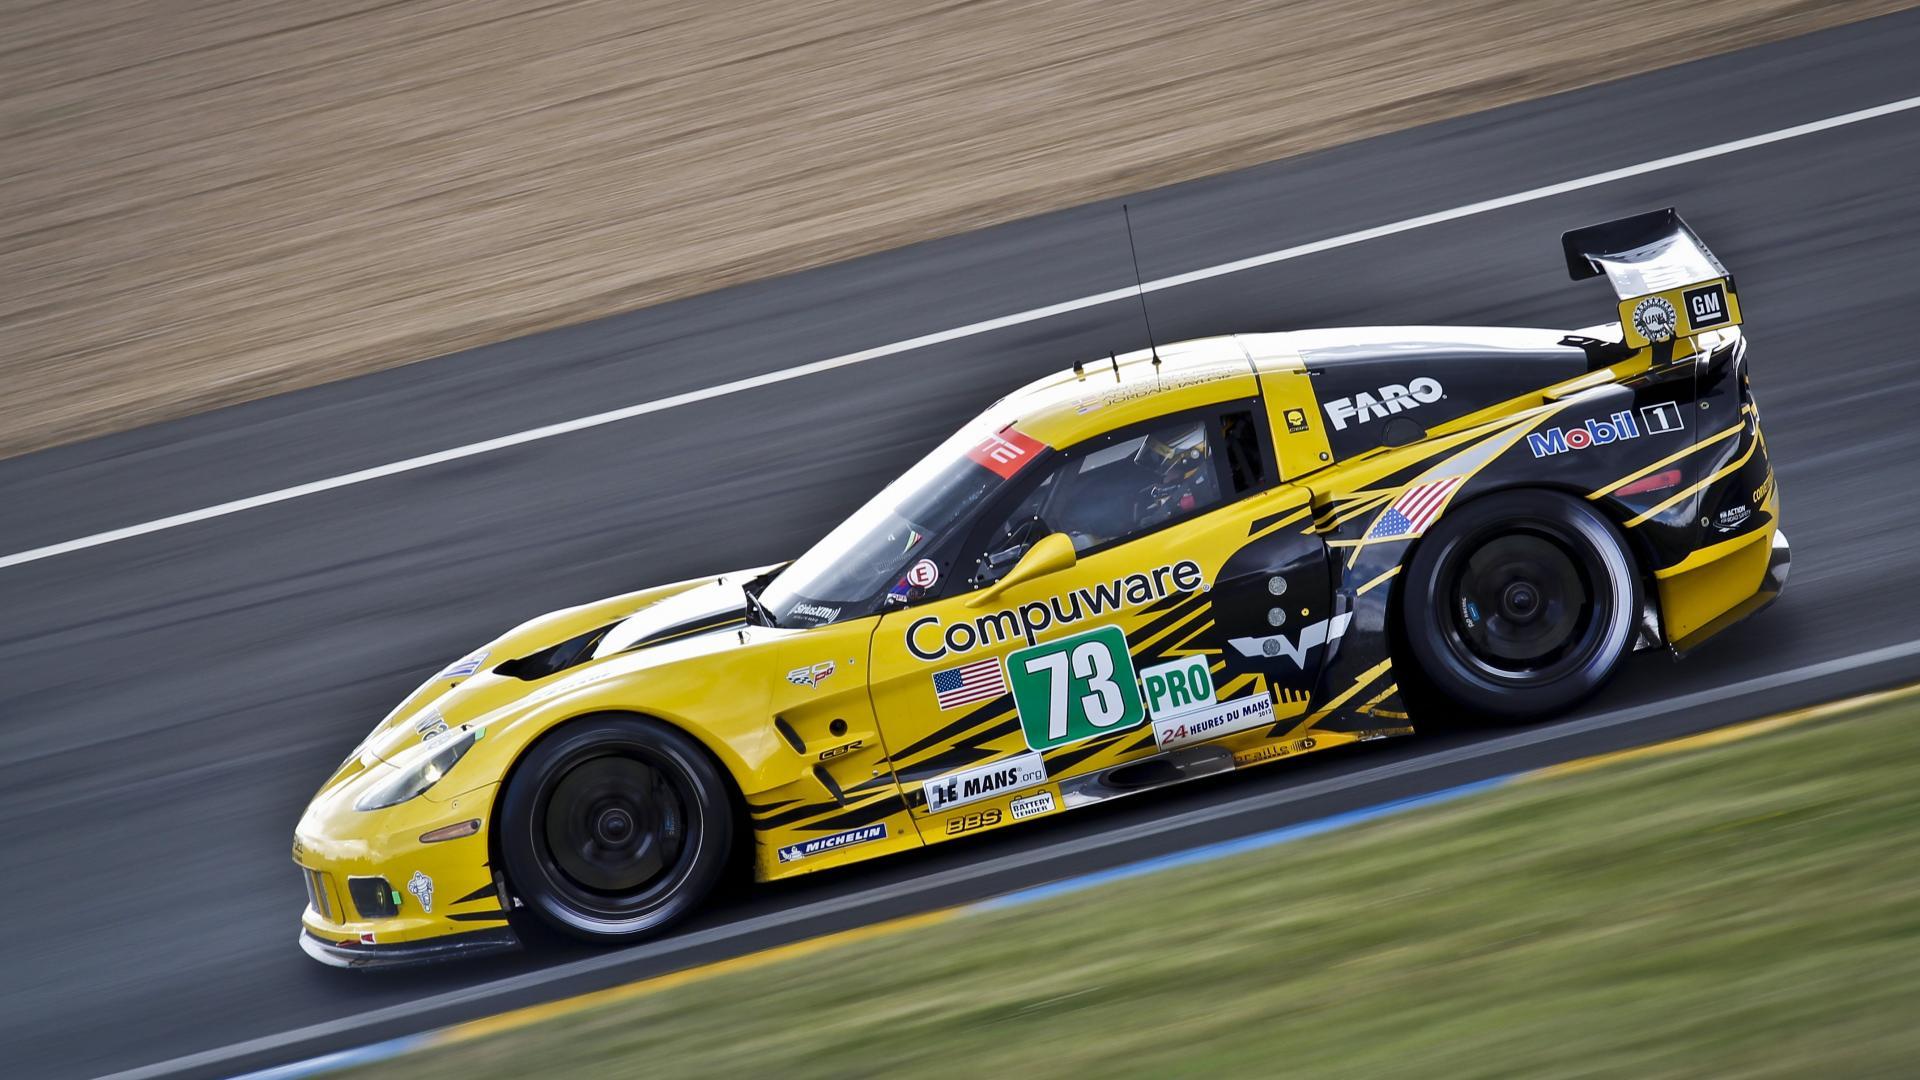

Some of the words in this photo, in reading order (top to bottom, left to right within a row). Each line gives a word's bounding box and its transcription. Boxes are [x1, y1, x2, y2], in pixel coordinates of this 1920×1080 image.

[1692, 292, 1720, 316] GM
[1323, 377, 1443, 431] FARO
[1527, 410, 1640, 458] Mobil
[1652, 407, 1670, 430] 1
[1727, 504, 1746, 517] ACTION
[915, 566, 929, 582] E
[903, 559, 1203, 662] Compuware
[1024, 640, 1126, 741] 73
[1145, 663, 1211, 713] PRO
[1162, 725, 1189, 745] 24
[1190, 715, 1224, 735] HEURES
[1226, 710, 1240, 722] DU
[1243, 698, 1270, 717] MANS
[938, 784, 958, 804] LE
[963, 767, 1018, 798] MANS
[1013, 797, 1050, 812] BATTERY
[1016, 806, 1048, 817] TENDER
[946, 808, 1002, 835] BBS
[806, 827, 881, 852] MICHELIN
